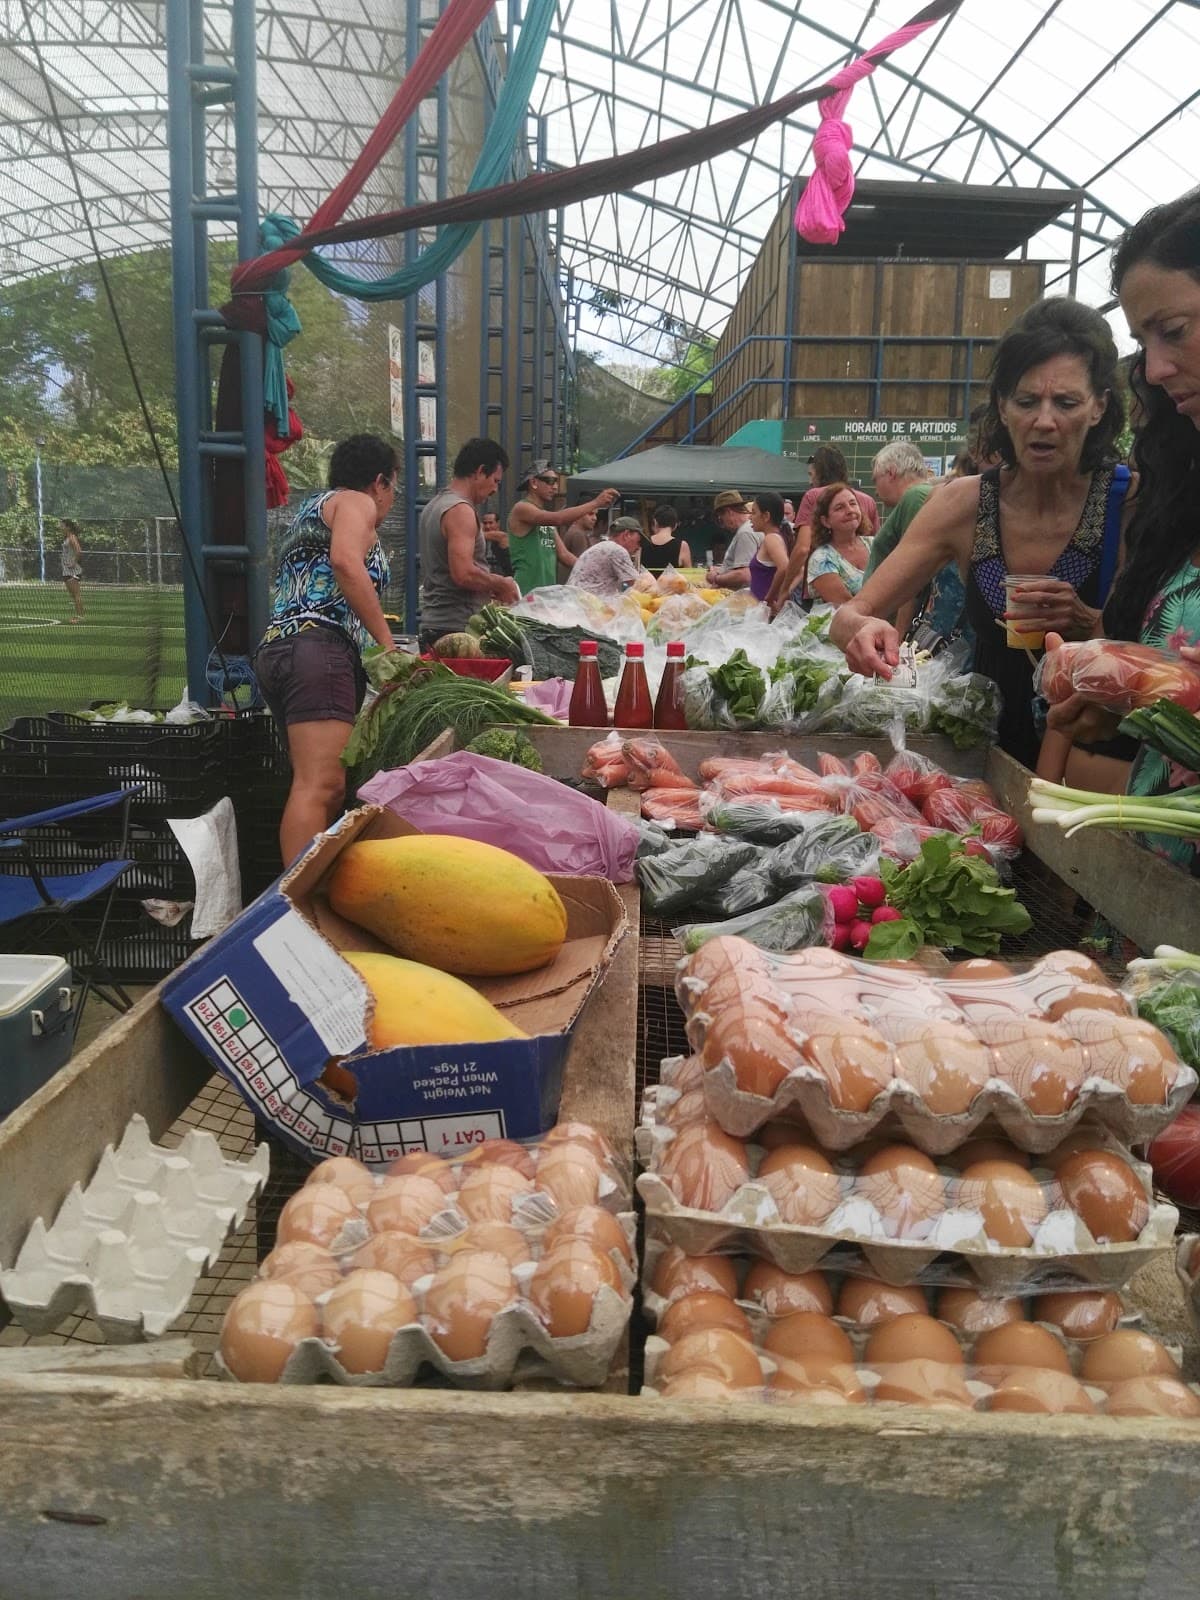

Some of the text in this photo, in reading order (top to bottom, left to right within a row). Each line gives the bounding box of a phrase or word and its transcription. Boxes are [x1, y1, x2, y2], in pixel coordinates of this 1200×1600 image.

[845, 422, 957, 433] HORARIO DE PARTIDOS
[198, 1002, 214, 1020] 216
[212, 1022, 228, 1038] 198
[225, 1040, 241, 1057] 175
[241, 1059, 256, 1075] 163
[430, 1061, 477, 1074] 21 Kgs.
[254, 1077, 268, 1094] 150
[413, 1071, 498, 1090] When Packed
[423, 1085, 491, 1100] Net Weight
[296, 1121, 314, 1137] 113
[442, 1129, 486, 1146] CAT 1
[363, 1149, 376, 1158] 72
[386, 1148, 400, 1157] 64
